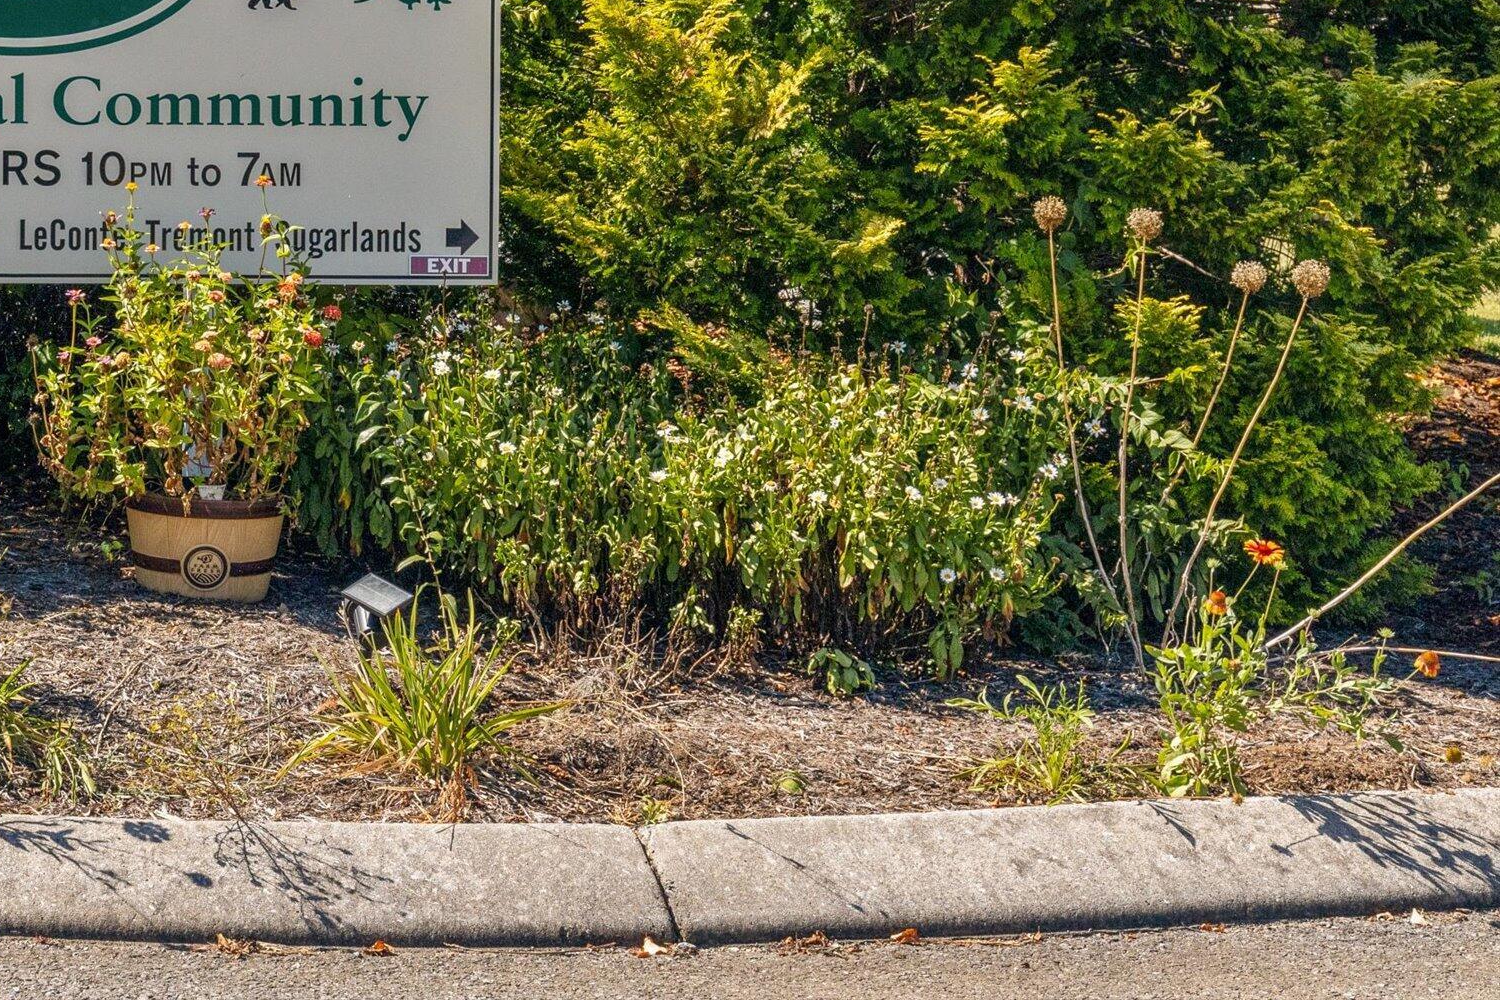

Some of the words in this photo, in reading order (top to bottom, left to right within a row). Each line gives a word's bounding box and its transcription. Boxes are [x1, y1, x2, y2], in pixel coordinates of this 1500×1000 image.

[52, 75, 429, 142] Community
[81, 150, 172, 187] 10PM
[186, 157, 222, 187] to
[145, 219, 255, 252] Tremont
[426, 257, 472, 274] EXIT
